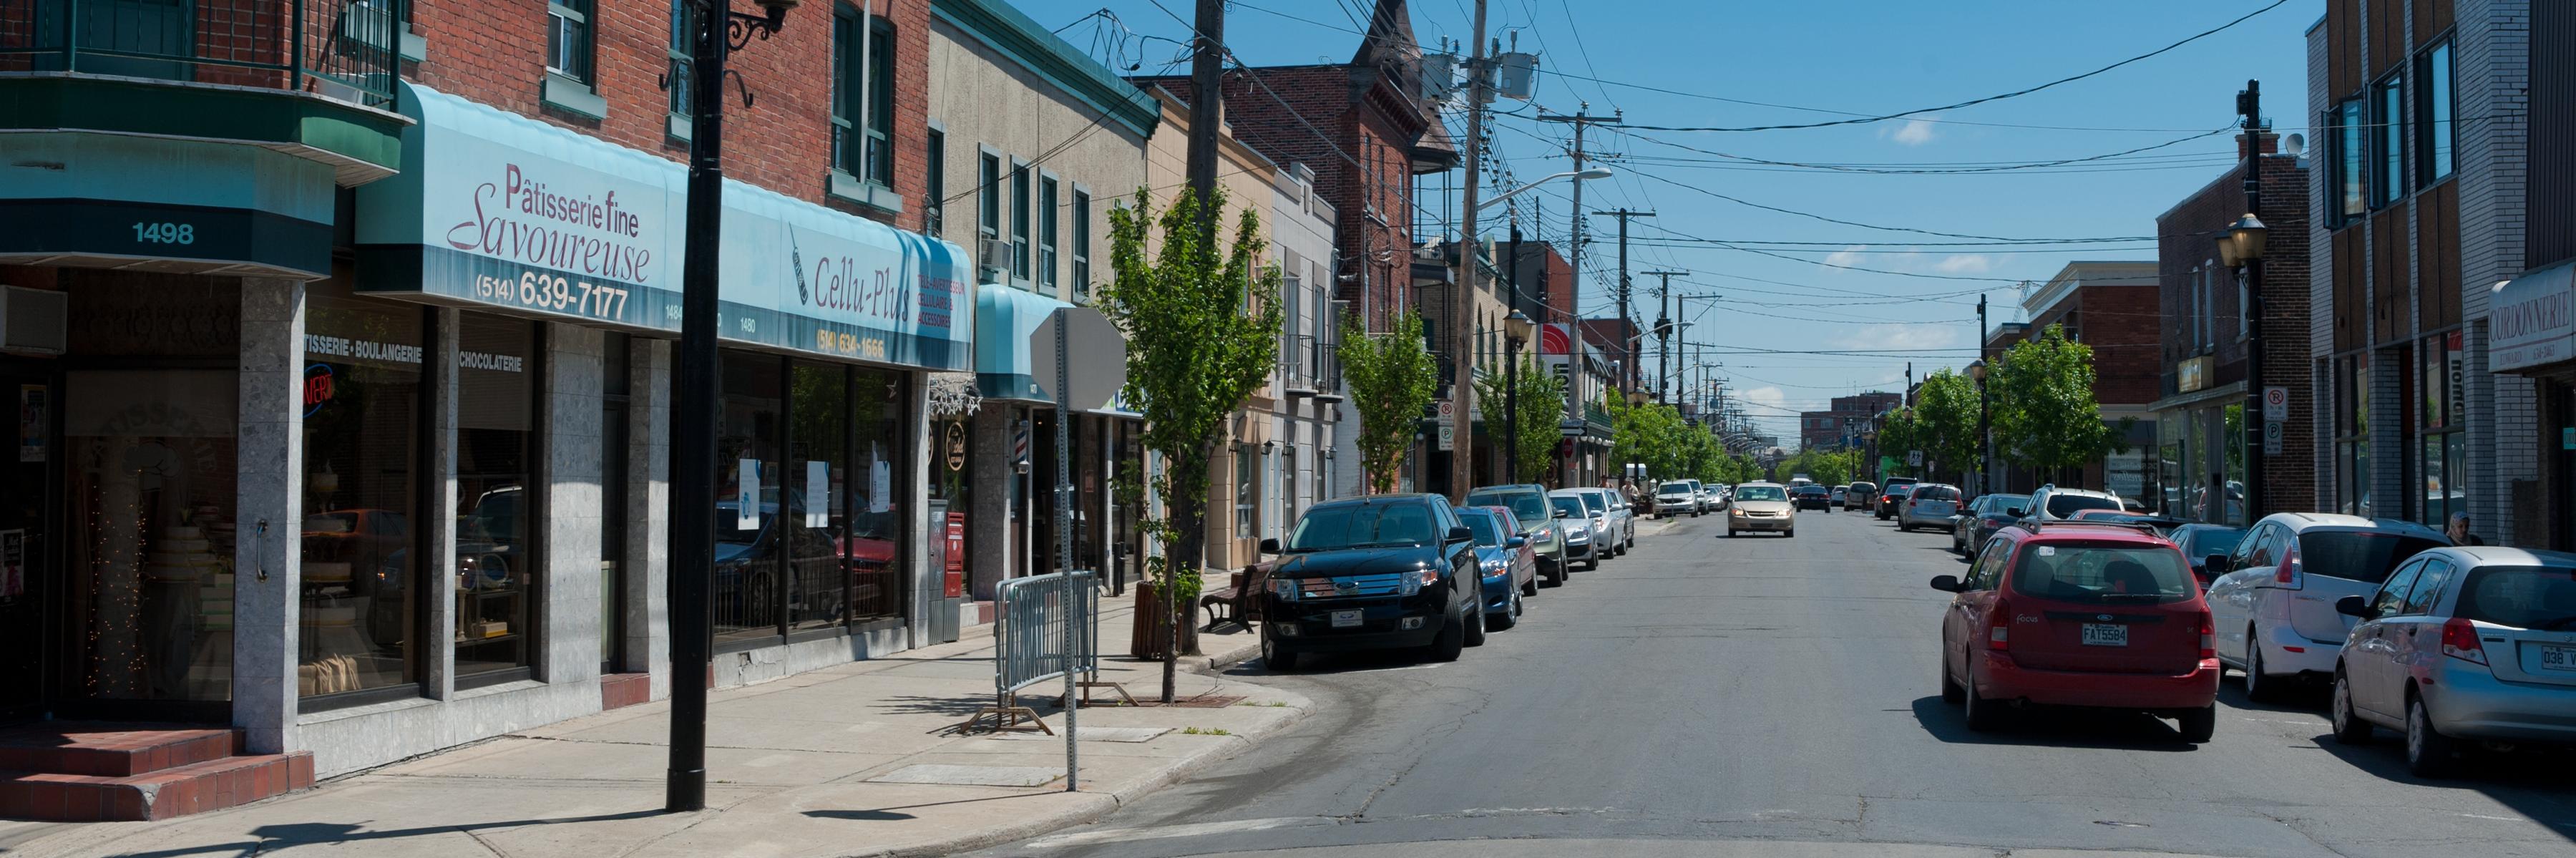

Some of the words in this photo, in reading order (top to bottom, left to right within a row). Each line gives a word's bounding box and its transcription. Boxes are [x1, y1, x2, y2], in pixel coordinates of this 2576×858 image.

[506, 163, 602, 229] Pâtisserie
[605, 190, 639, 238] fine
[132, 222, 194, 245] 1498
[447, 183, 650, 283] Savoureuse
[476, 274, 514, 301] (514)
[519, 271, 628, 320] 639-7177
[815, 256, 909, 321] Cellu-Plus
[665, 304, 683, 321] 1484
[917, 311, 951, 328] ACCESSOIRES
[2490, 291, 2570, 342] CORDONNERIE
[741, 317, 756, 333] 1480
[356, 340, 423, 364] BOULANGERIE
[817, 329, 836, 351] (514)
[839, 333, 884, 358] 634-1666
[459, 351, 522, 372] CHOCOLATERIE
[2084, 628, 2126, 642] FAT5584
[2544, 651, 2563, 665] 038
